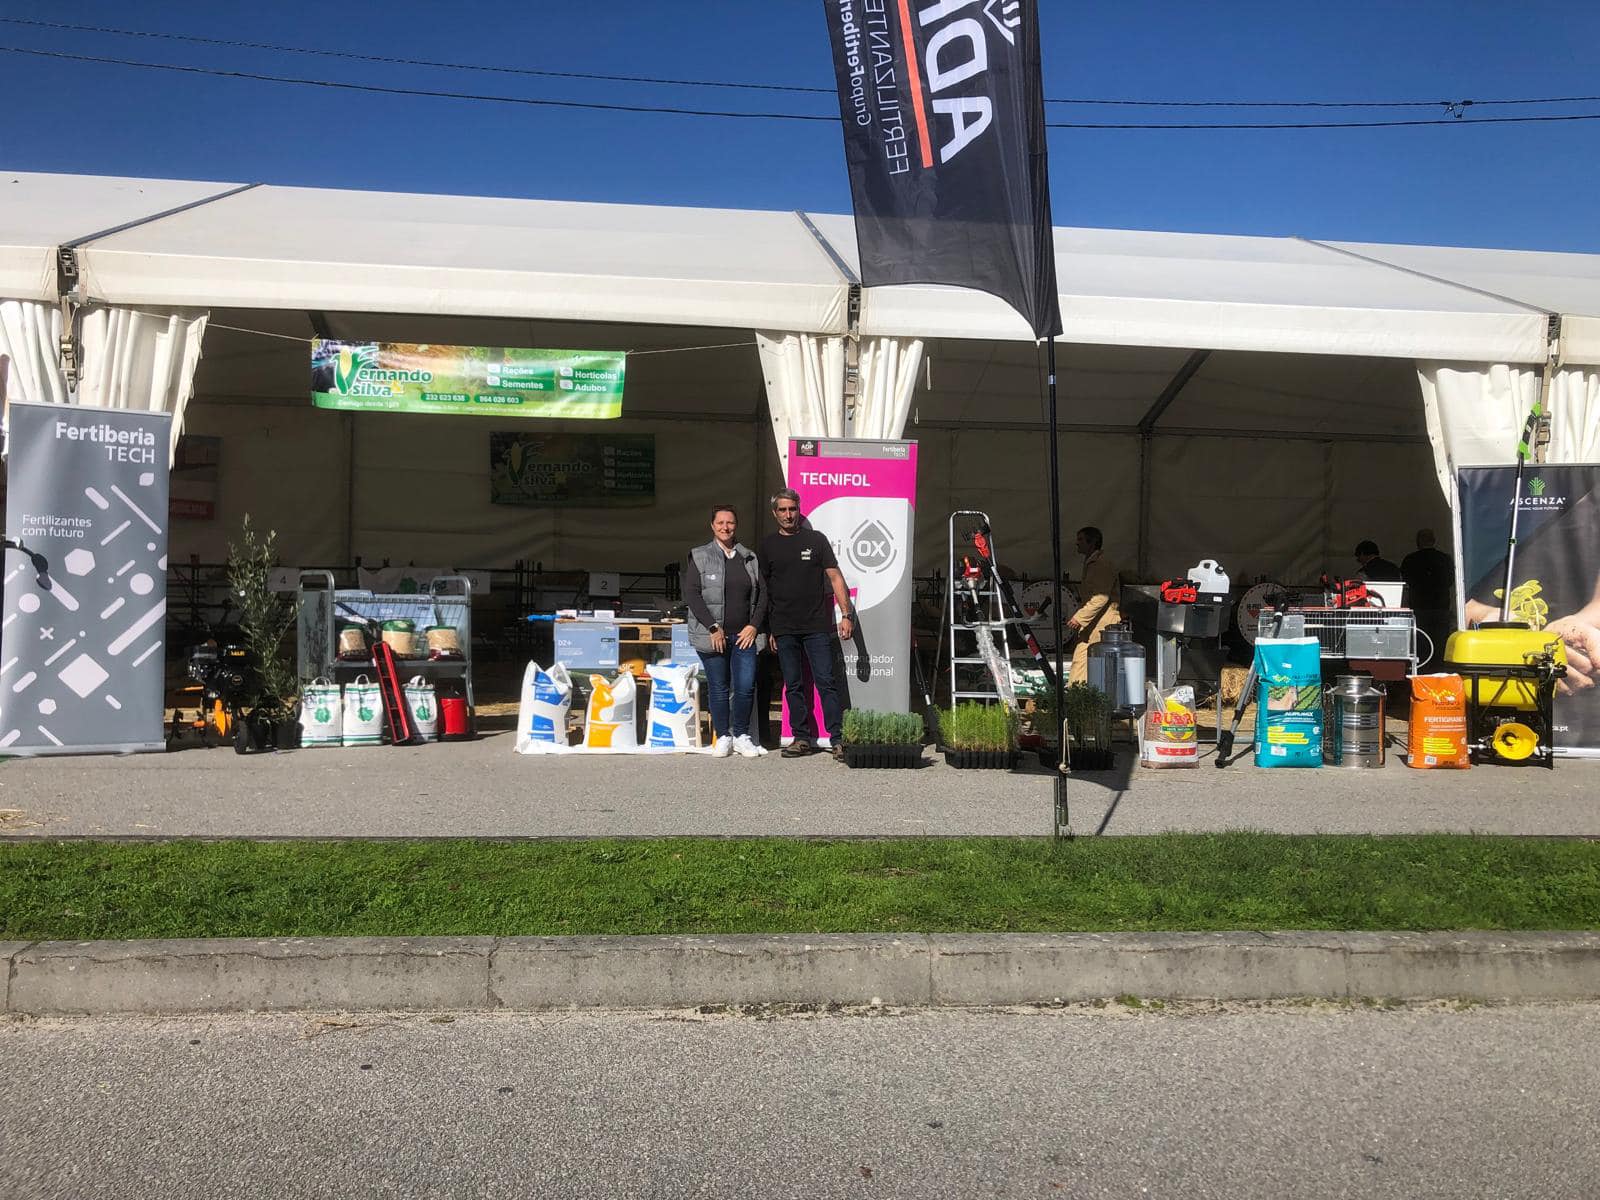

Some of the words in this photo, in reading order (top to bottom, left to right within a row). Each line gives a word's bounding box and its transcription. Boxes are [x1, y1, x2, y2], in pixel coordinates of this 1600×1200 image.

[502, 379, 544, 390] Sementes
[575, 382, 607, 392] Adubos
[55, 421, 155, 446] Fertiberia
[105, 446, 155, 464] TECH
[800, 472, 871, 487] TECNIFOL
[22, 514, 92, 528] Fertilizantes
[22, 528, 46, 536] com
[50, 527, 84, 537] futuro
[601, 581, 607, 590] 2
